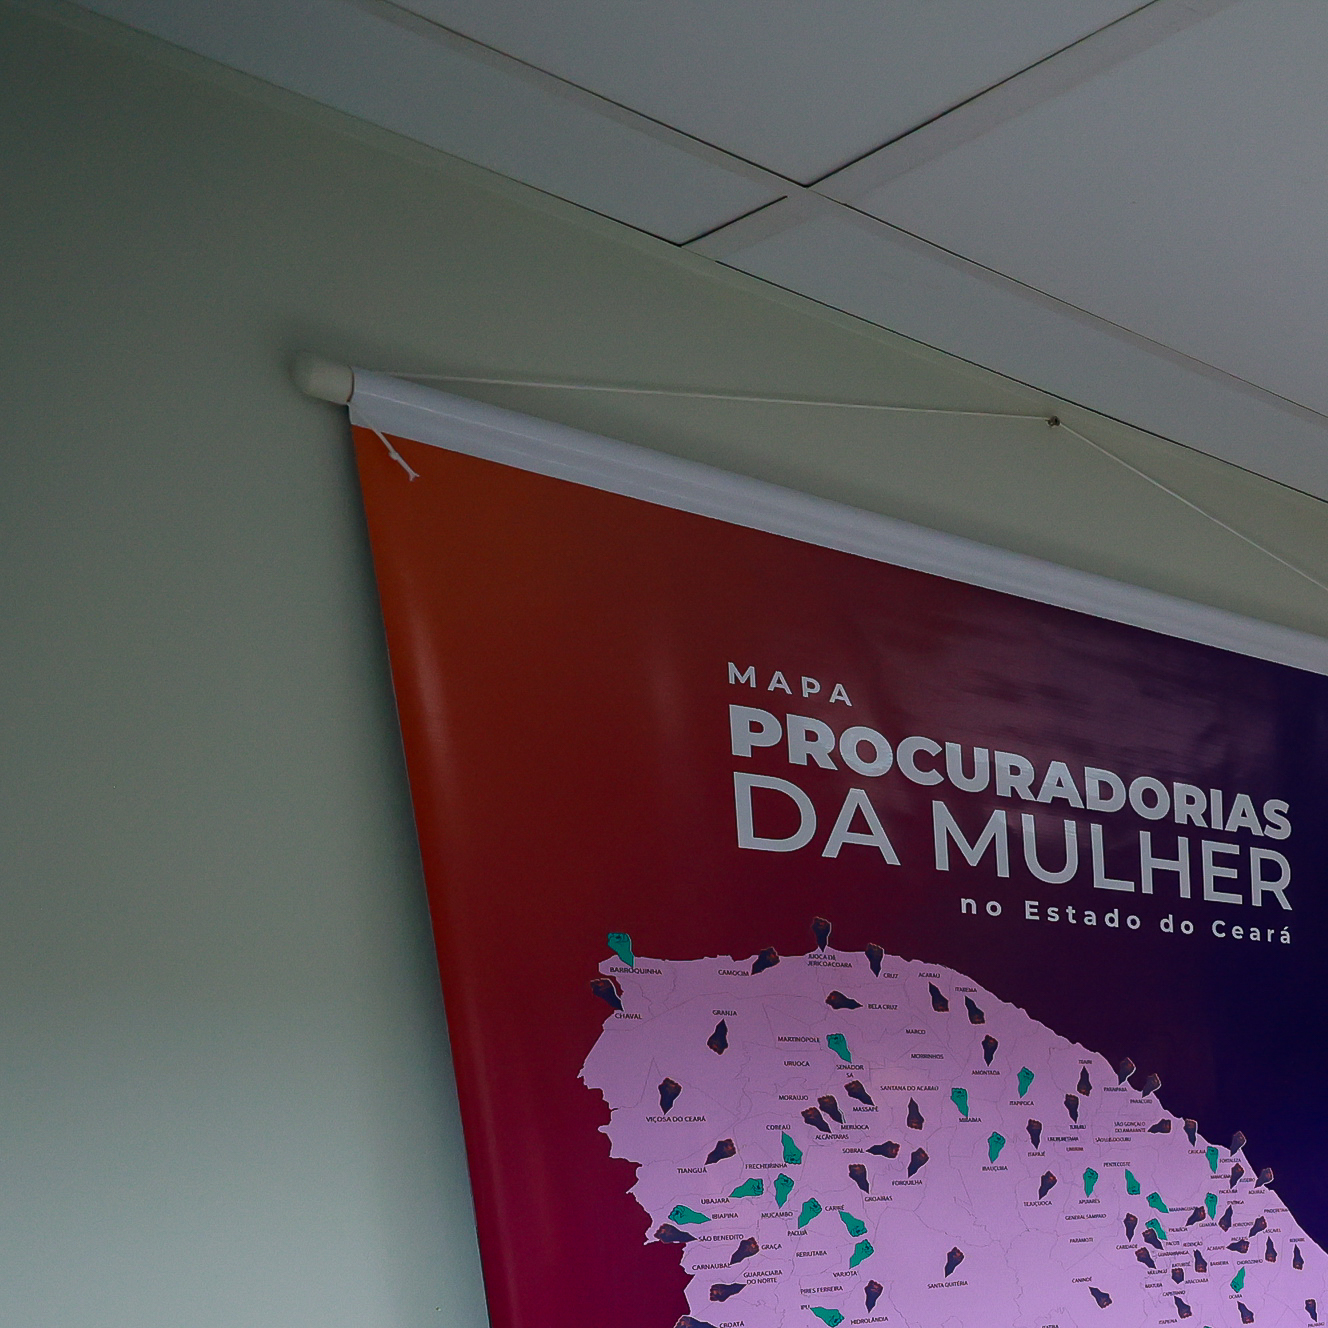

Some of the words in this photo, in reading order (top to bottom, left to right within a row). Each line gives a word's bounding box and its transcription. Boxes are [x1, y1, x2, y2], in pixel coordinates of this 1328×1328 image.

[727, 662, 852, 707] MAPA
[728, 704, 1292, 840] PROCURADORIAS
[734, 771, 901, 865] DA
[932, 801, 1293, 911] MULHER
[961, 896, 1002, 917] no
[1025, 901, 1141, 930] Estado
[1160, 913, 1194, 935] do
[1211, 919, 1292, 945] Ceará
[610, 967, 662, 975] BARROQUINHA
[713, 1234, 744, 1242] BENEDITO
[762, 1243, 782, 1251] GRAÇA
[744, 1270, 782, 1278] GUARACIABA
[817, 1285, 843, 1293] FERREIRA
[851, 1316, 888, 1325] HIDROLÂNDIA
